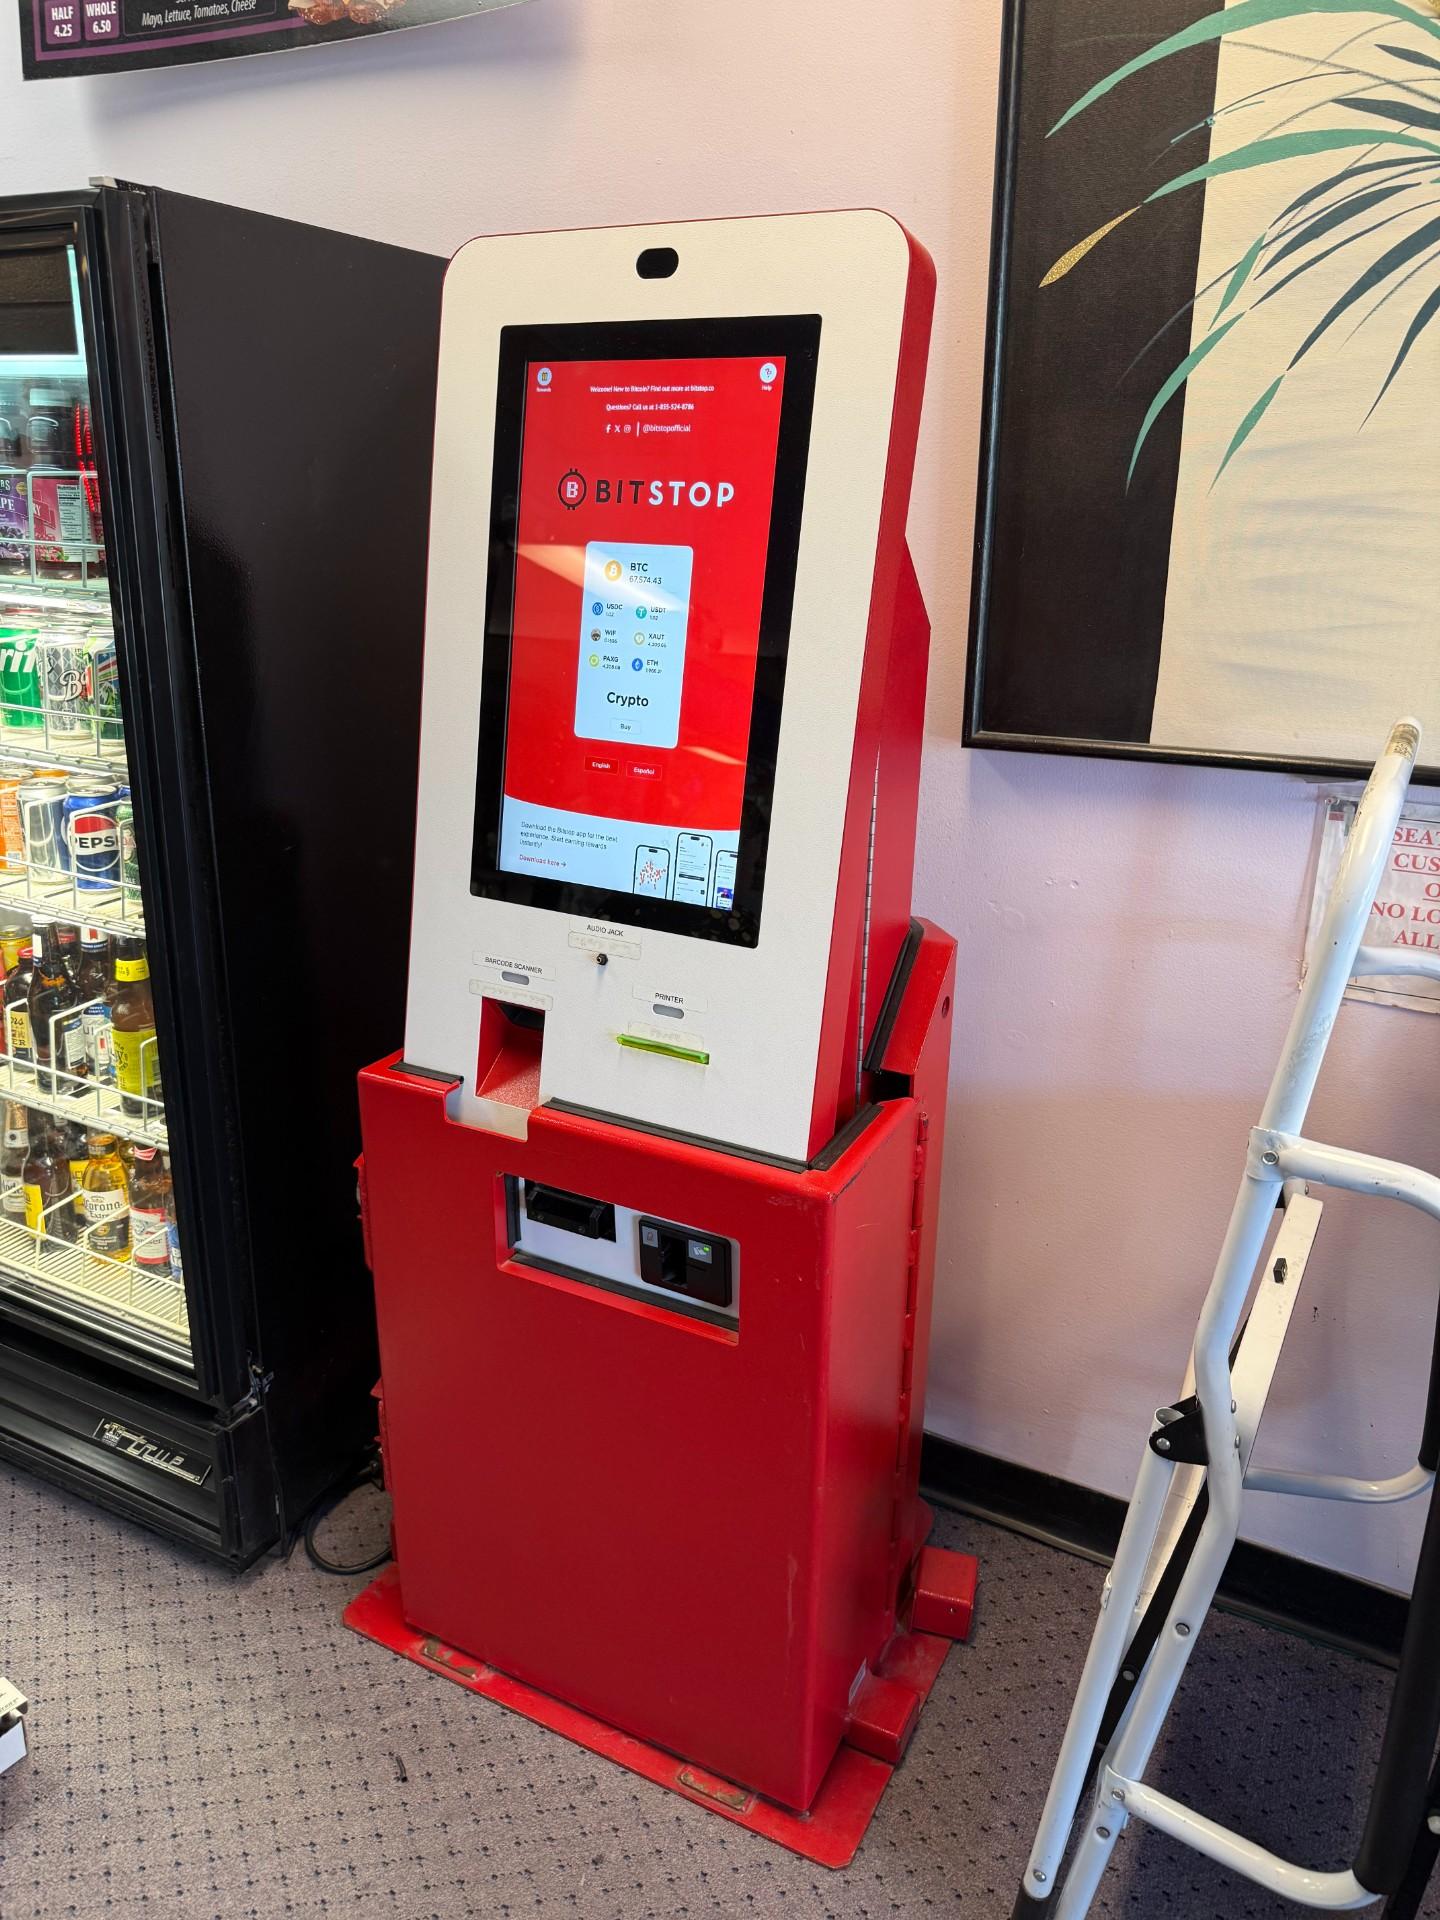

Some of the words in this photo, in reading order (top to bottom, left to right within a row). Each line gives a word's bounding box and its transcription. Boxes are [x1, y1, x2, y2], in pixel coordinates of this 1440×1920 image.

[51, 6, 74, 20] HALF
[86, 1, 117, 17] WHOLE
[142, 12, 163, 28] Mayo,
[165, 9, 192, 22] Lettuce,
[194, 3, 230, 18] Tomatoes,
[231, 0, 257, 12] Cheese
[54, 24, 73, 37] 4.25
[92, 20, 112, 33] 6.50
[643, 423, 691, 433] @bitstopofficial
[595, 479, 735, 507] BITSTOP
[0, 497, 15, 511] PE
[630, 562, 648, 572] BTC
[646, 659, 659, 667] ETH
[606, 691, 649, 708] Crypto
[620, 723, 632, 732] Buy
[591, 760, 611, 770] English
[633, 765, 655, 776] Español
[521, 822, 546, 831] Download
[551, 835, 564, 843] Start
[564, 838, 585, 848] earning
[1393, 826, 1440, 845] SEA
[519, 854, 547, 864] Download
[547, 859, 560, 867] here
[1393, 852, 1440, 873] CUS
[1370, 900, 1405, 918] NO
[586, 924, 607, 935] AUDIO
[607, 928, 624, 938] JACK
[484, 956, 513, 968] BARCODE
[514, 962, 543, 975] SCANNER
[654, 992, 684, 1005] PRINTER
[86, 1200, 122, 1212] Corona
